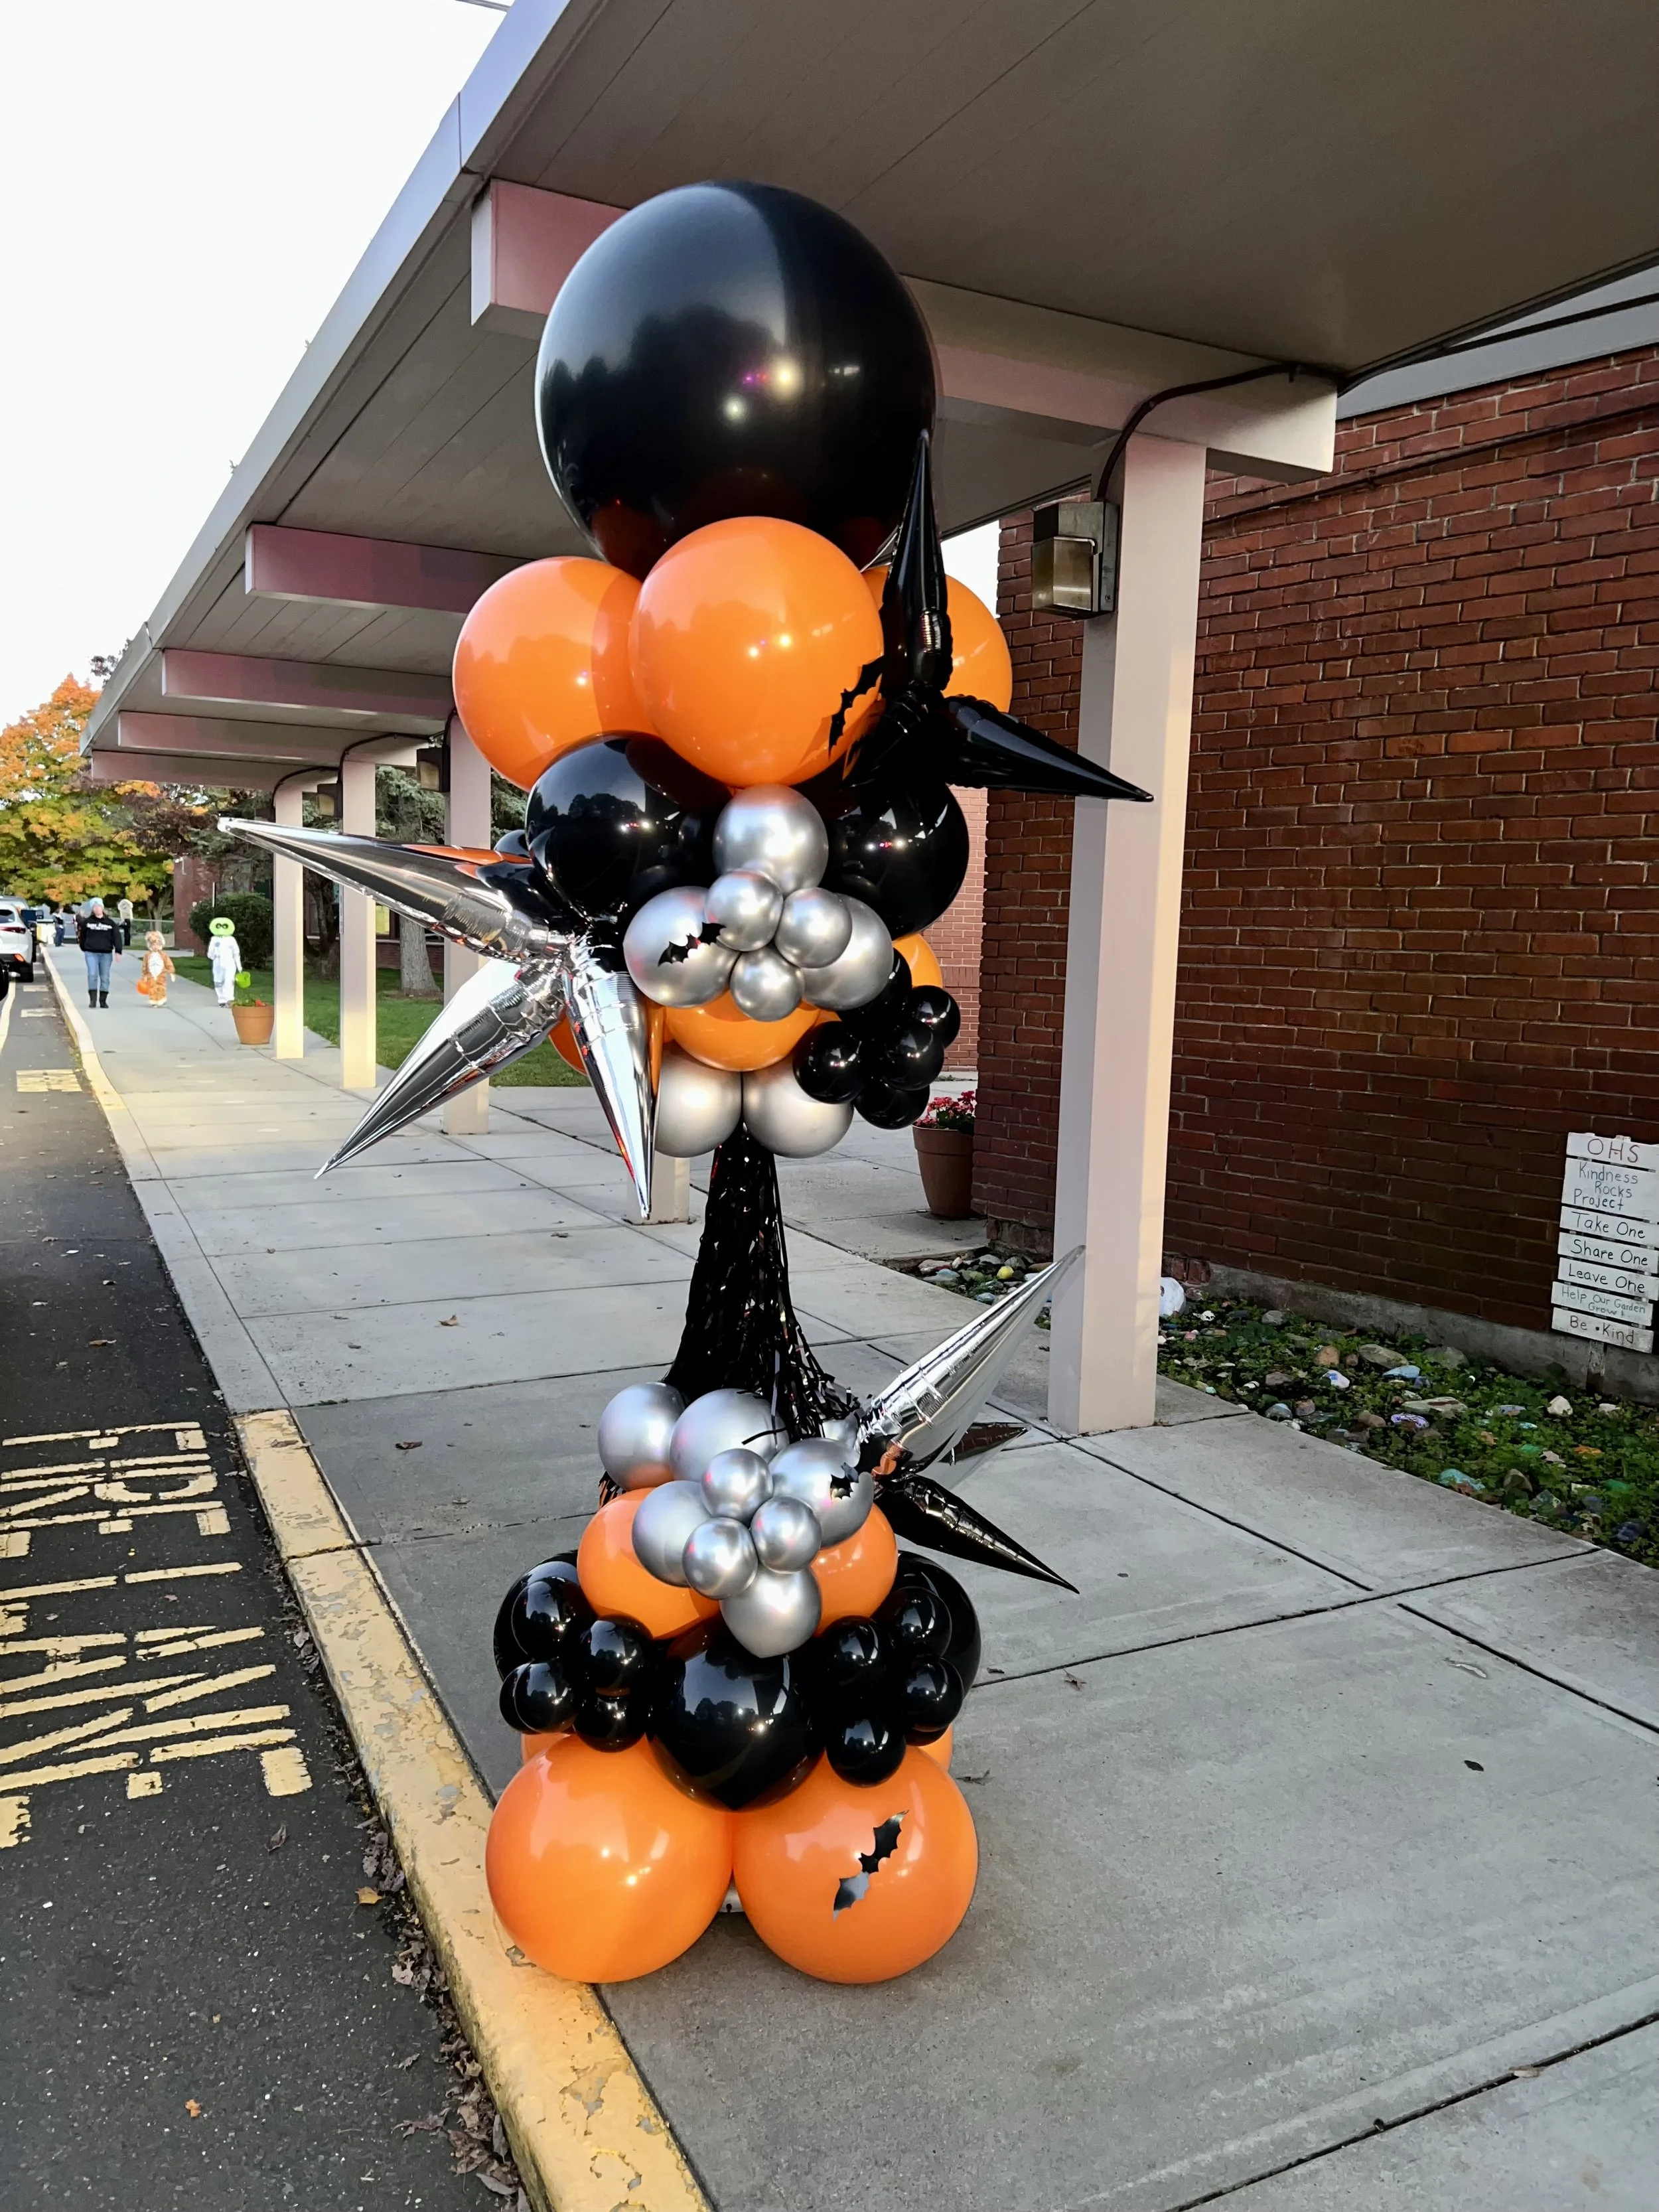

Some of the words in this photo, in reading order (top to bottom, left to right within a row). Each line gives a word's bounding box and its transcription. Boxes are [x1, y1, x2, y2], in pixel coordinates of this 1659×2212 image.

[1587, 1138, 1640, 1163] OHS
[1579, 1161, 1638, 1185] Kindness
[1573, 1188, 1624, 1211] Project
[1595, 1180, 1632, 1198] Rocks
[1571, 1211, 1609, 1233] Take
[1616, 1221, 1646, 1239] One
[1570, 1238, 1614, 1260] Share
[1620, 1249, 1648, 1266] One
[1568, 1262, 1609, 1286] Leave
[1615, 1276, 1645, 1294] One
[1561, 1286, 1587, 1304] Help
[1593, 1294, 1611, 1305] Our
[1614, 1298, 1646, 1314] Garden
[1569, 1315, 1588, 1331] Be
[0, 1421, 231, 1558] FIRE
[0, 1562, 313, 1849] LANE
